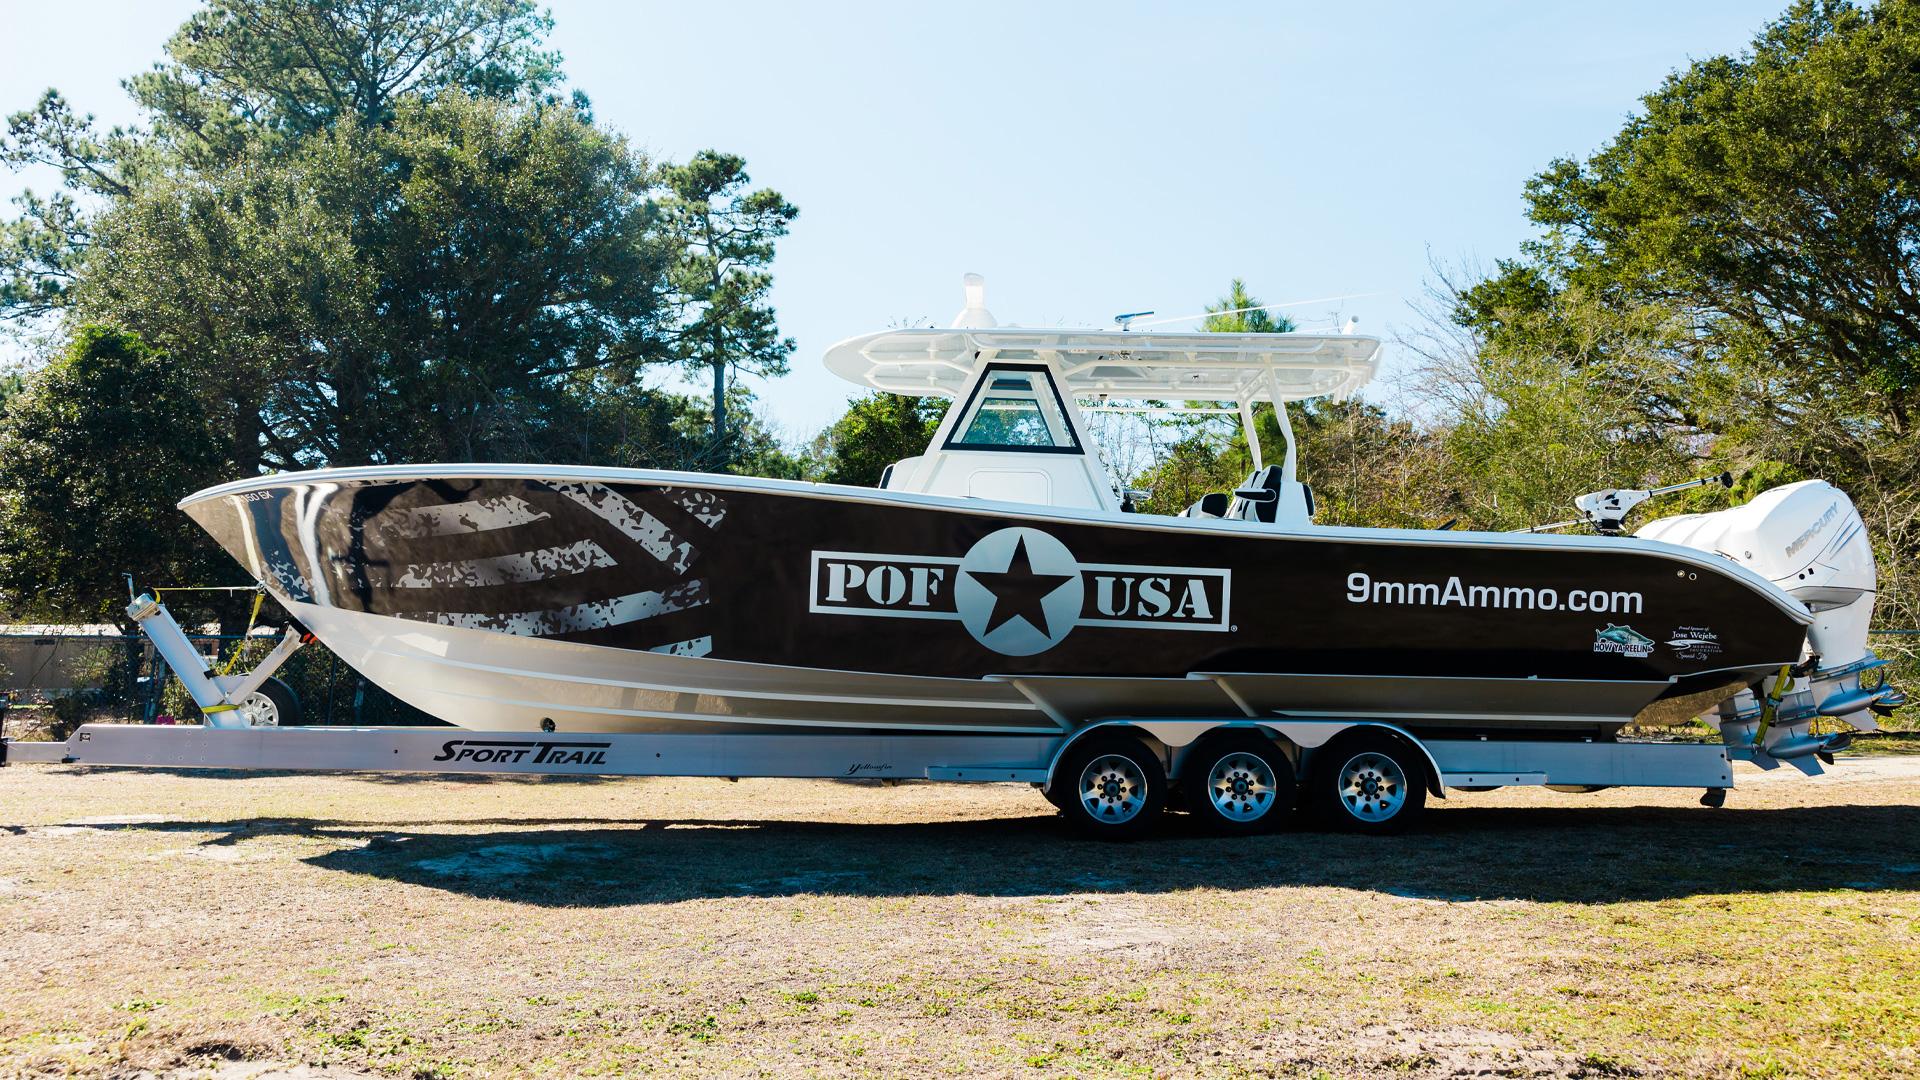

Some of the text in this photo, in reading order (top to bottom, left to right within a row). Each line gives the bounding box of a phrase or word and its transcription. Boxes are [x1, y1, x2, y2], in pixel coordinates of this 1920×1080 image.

[1785, 501, 1838, 558] MERCURY
[825, 563, 944, 606] POF
[1095, 576, 1213, 619] USA
[1347, 572, 1643, 614] 9mmAmmo.com
[1671, 630, 1688, 639] Jose
[433, 740, 612, 765] SPORT TRAIL
